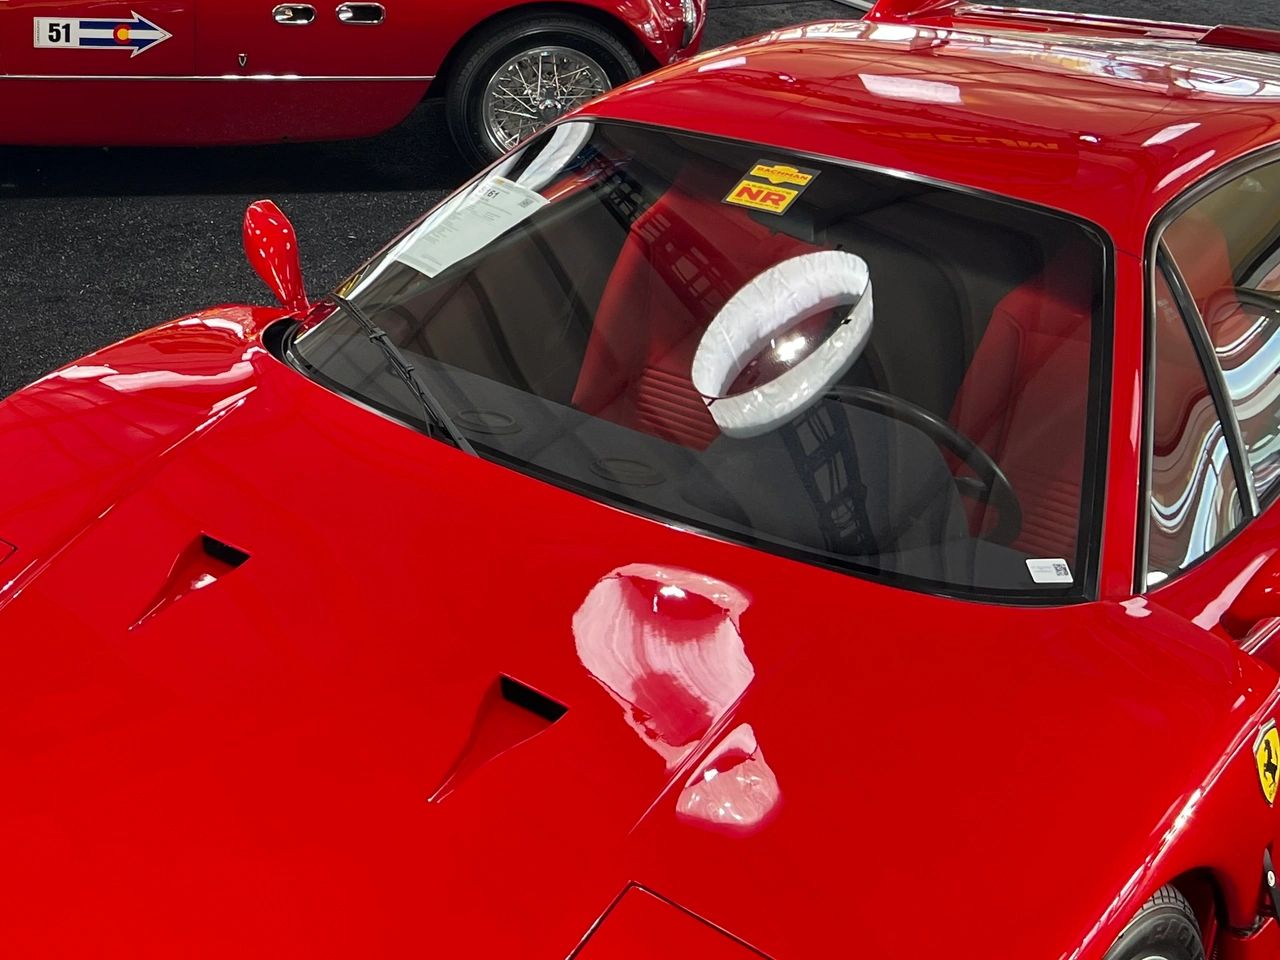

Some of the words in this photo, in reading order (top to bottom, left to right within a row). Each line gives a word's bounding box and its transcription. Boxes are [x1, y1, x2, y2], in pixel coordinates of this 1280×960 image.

[48, 23, 71, 43] 51
[757, 166, 809, 180] BACHMAN
[735, 186, 787, 206] NR
